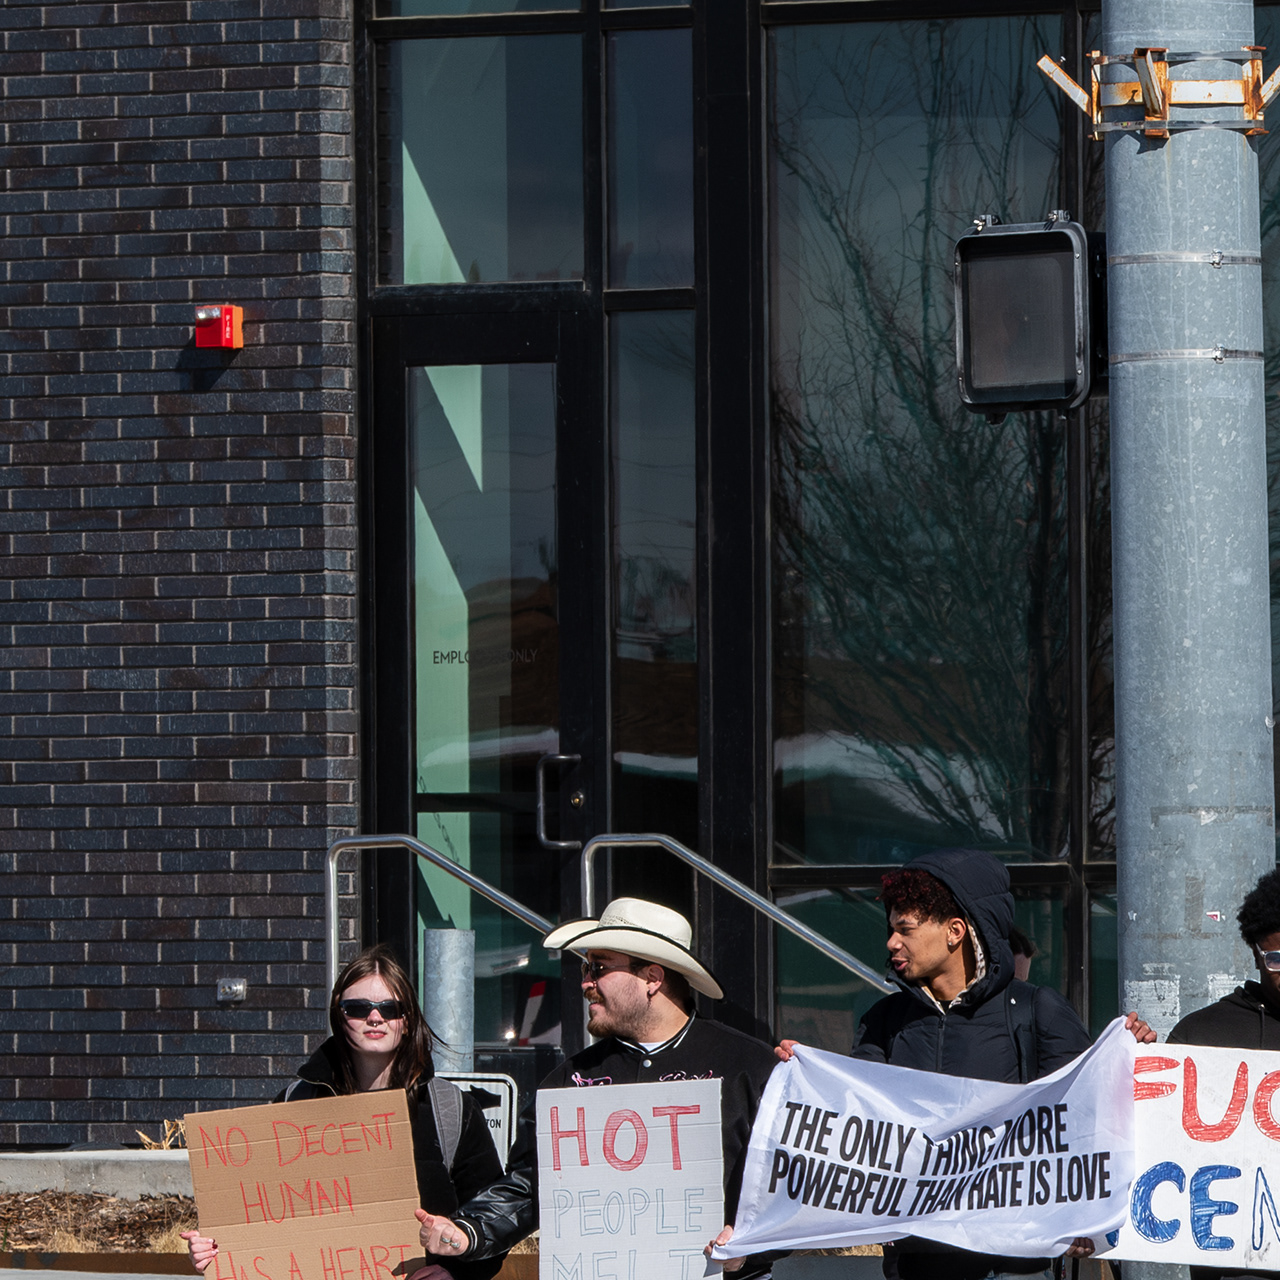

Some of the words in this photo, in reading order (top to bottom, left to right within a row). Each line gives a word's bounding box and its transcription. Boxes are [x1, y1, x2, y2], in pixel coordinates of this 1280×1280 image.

[199, 1125, 250, 1169] NO
[272, 1112, 396, 1168] DECENT
[550, 1104, 701, 1172] HOT
[780, 1101, 839, 1156] THE
[839, 1115, 917, 1173] ONLY
[919, 1125, 996, 1177] THING
[992, 1103, 1070, 1161] MORE
[239, 1176, 355, 1225] HUMAN
[552, 1187, 705, 1239] PEOPLE
[768, 1148, 908, 1217] POWERFUL
[906, 1170, 972, 1217] THAN
[966, 1160, 1025, 1211] HATE
[1027, 1158, 1051, 1206] IS
[1055, 1151, 1112, 1204] LOVE
